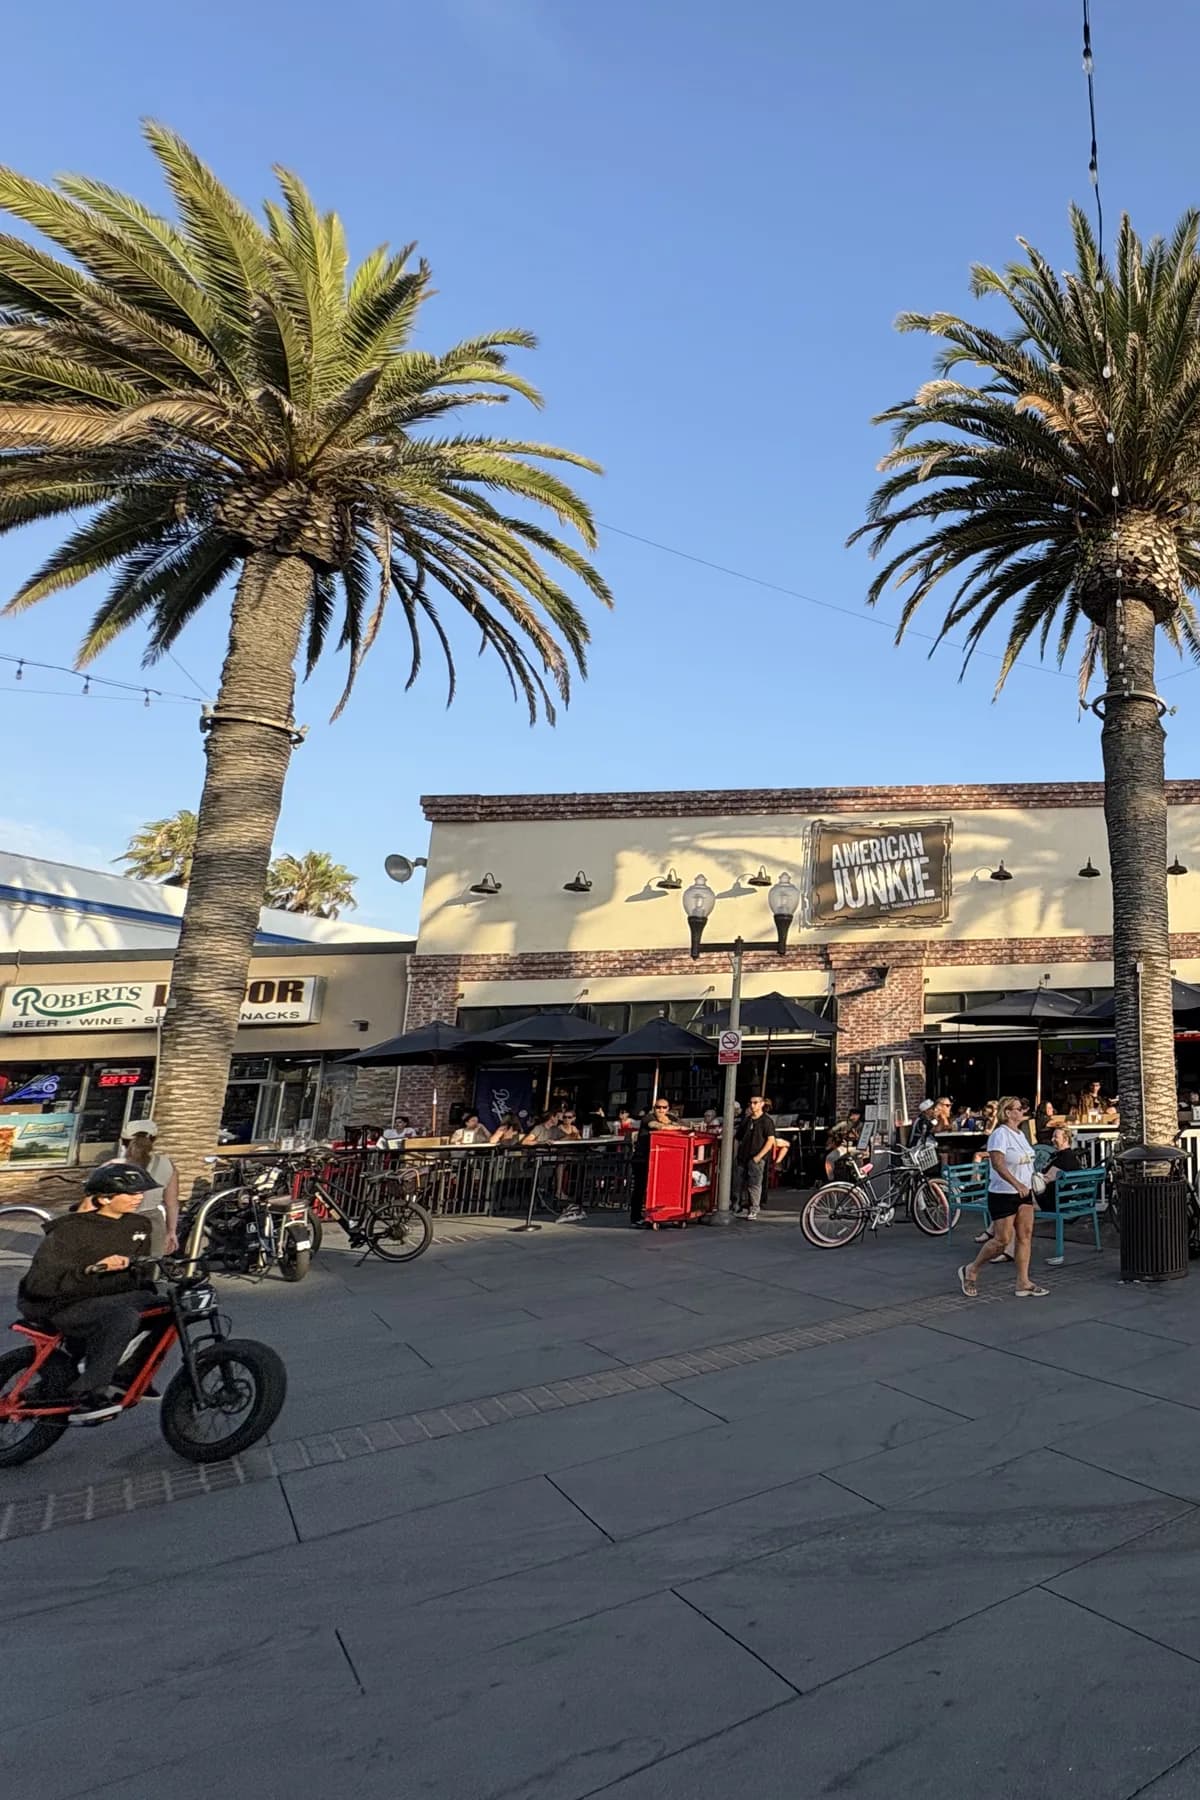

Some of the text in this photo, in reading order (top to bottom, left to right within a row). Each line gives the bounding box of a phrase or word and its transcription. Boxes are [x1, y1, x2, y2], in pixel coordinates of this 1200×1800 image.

[831, 832, 925, 869] AMERICAN
[832, 856, 936, 912] JUNKIE
[12, 986, 142, 1017] ROBERTS
[11, 1011, 300, 1029] BEER WINE NACKS
